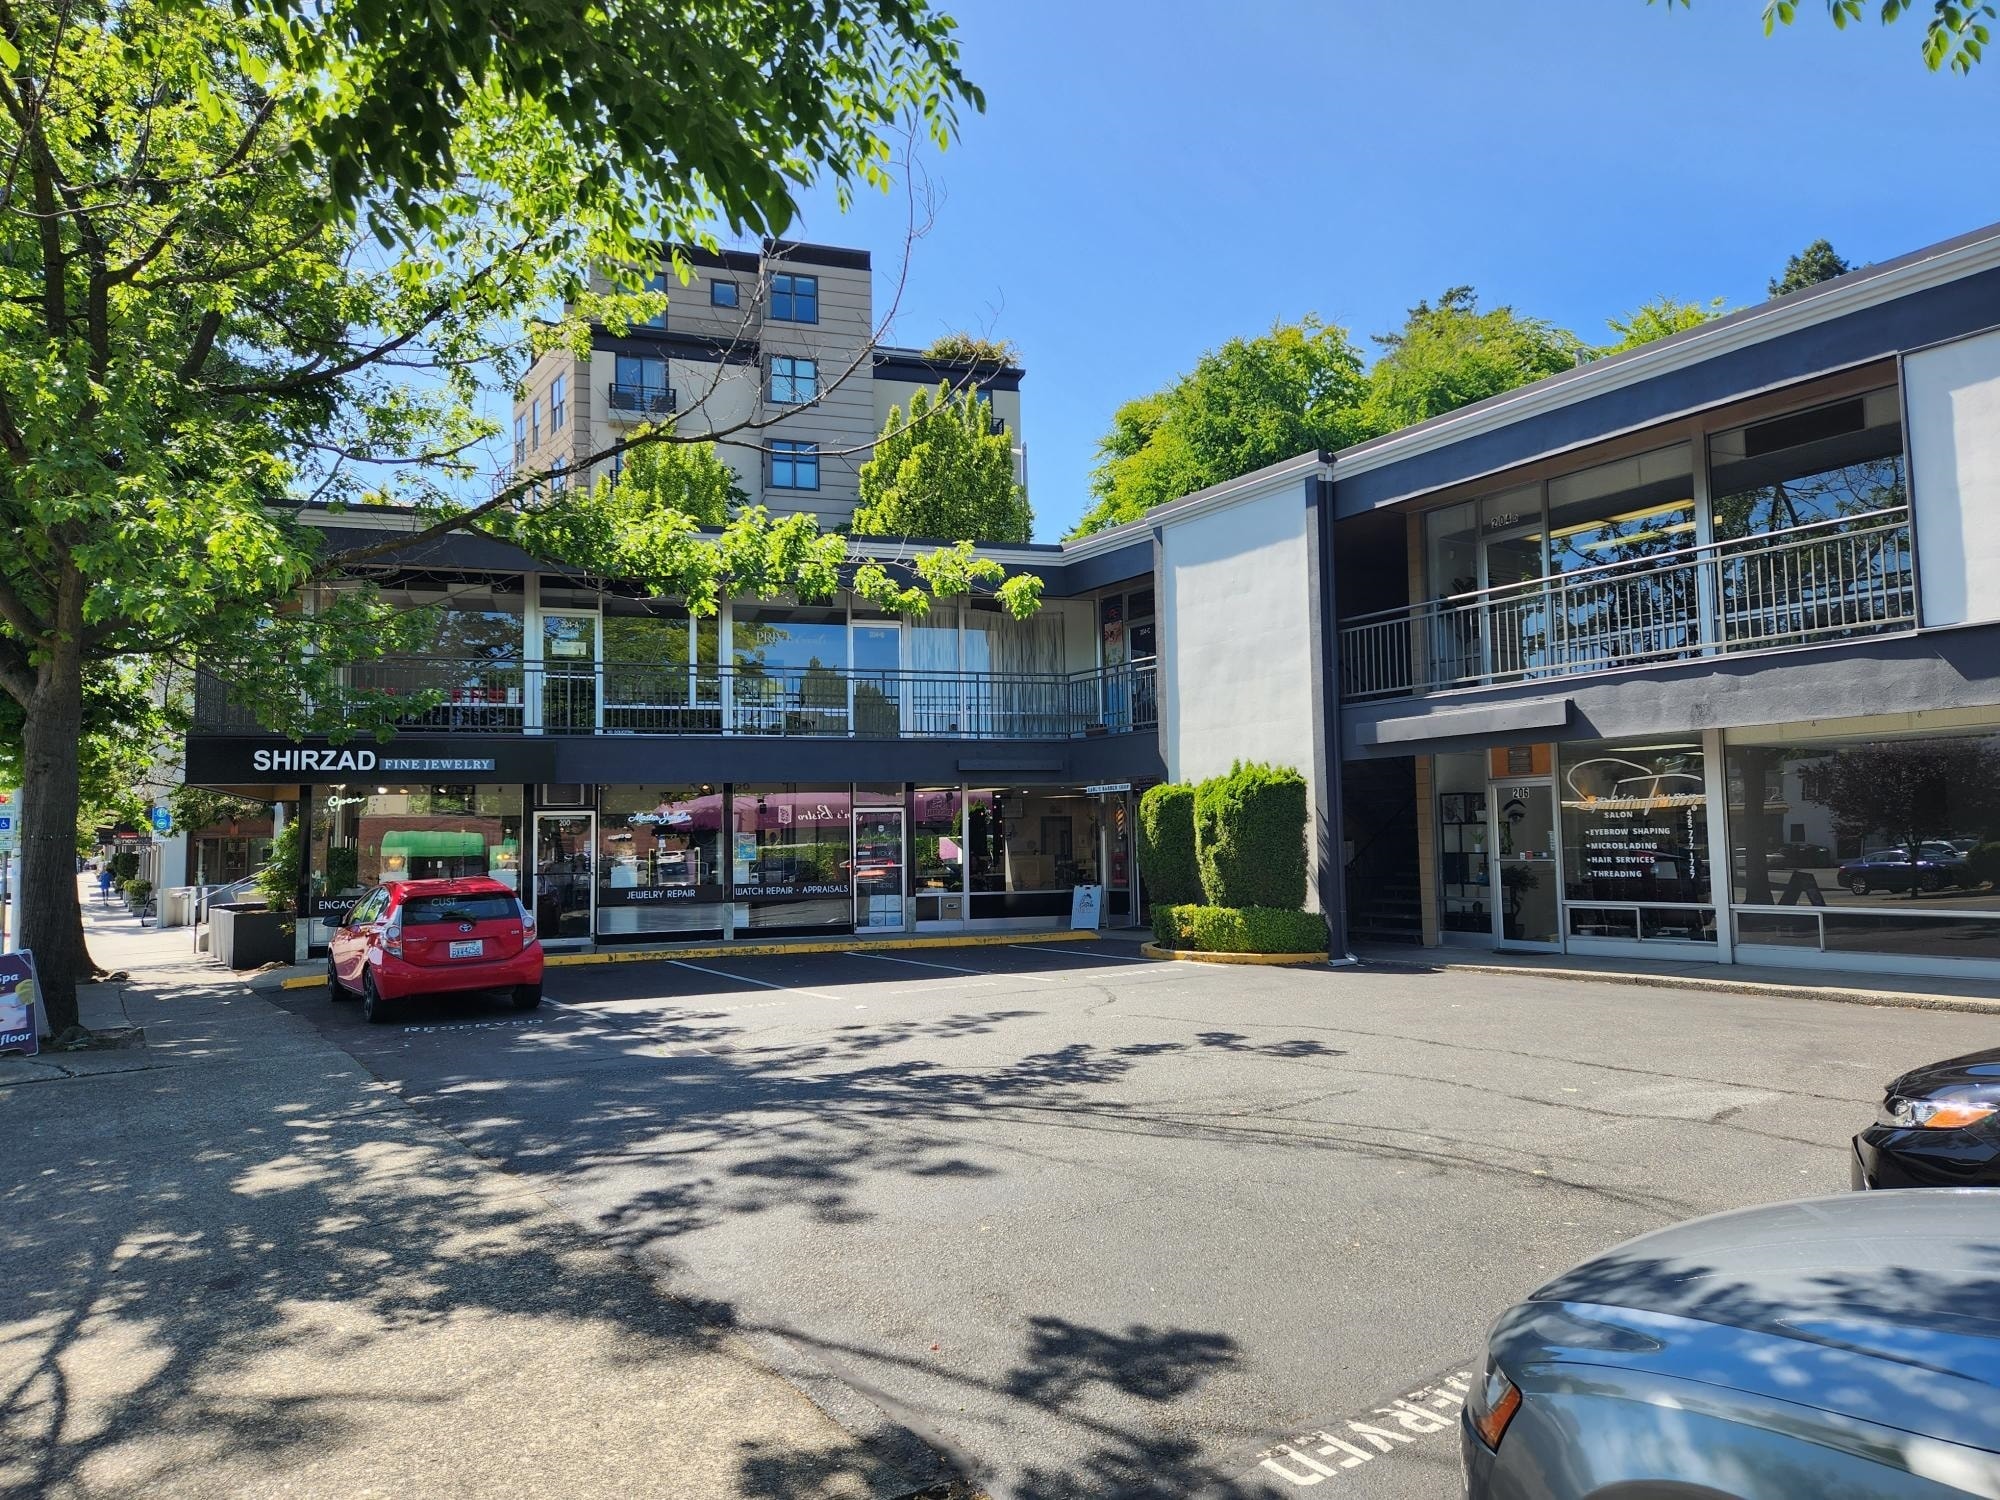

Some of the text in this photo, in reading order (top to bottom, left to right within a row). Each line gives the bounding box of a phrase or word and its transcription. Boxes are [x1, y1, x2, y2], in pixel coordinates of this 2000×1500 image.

[253, 749, 492, 771] SHIRZAD FINE JEWELRY
[1512, 787, 1530, 799] 206
[327, 795, 366, 809] Open
[1603, 811, 1633, 819] SALON
[560, 819, 570, 827] 200
[1590, 827, 1671, 836] EYEBROW SHAPING
[1590, 842, 1658, 850] MICROBLADING
[1591, 856, 1656, 864] HAIR SERVICES
[1592, 870, 1642, 878] THREADING
[626, 889, 696, 900] JEWELRY REPAIR
[735, 884, 849, 896] WATCH REPAIR APPRAISALS
[403, 1018, 544, 1033] RESERVED
[0, 1032, 32, 1046] floor
